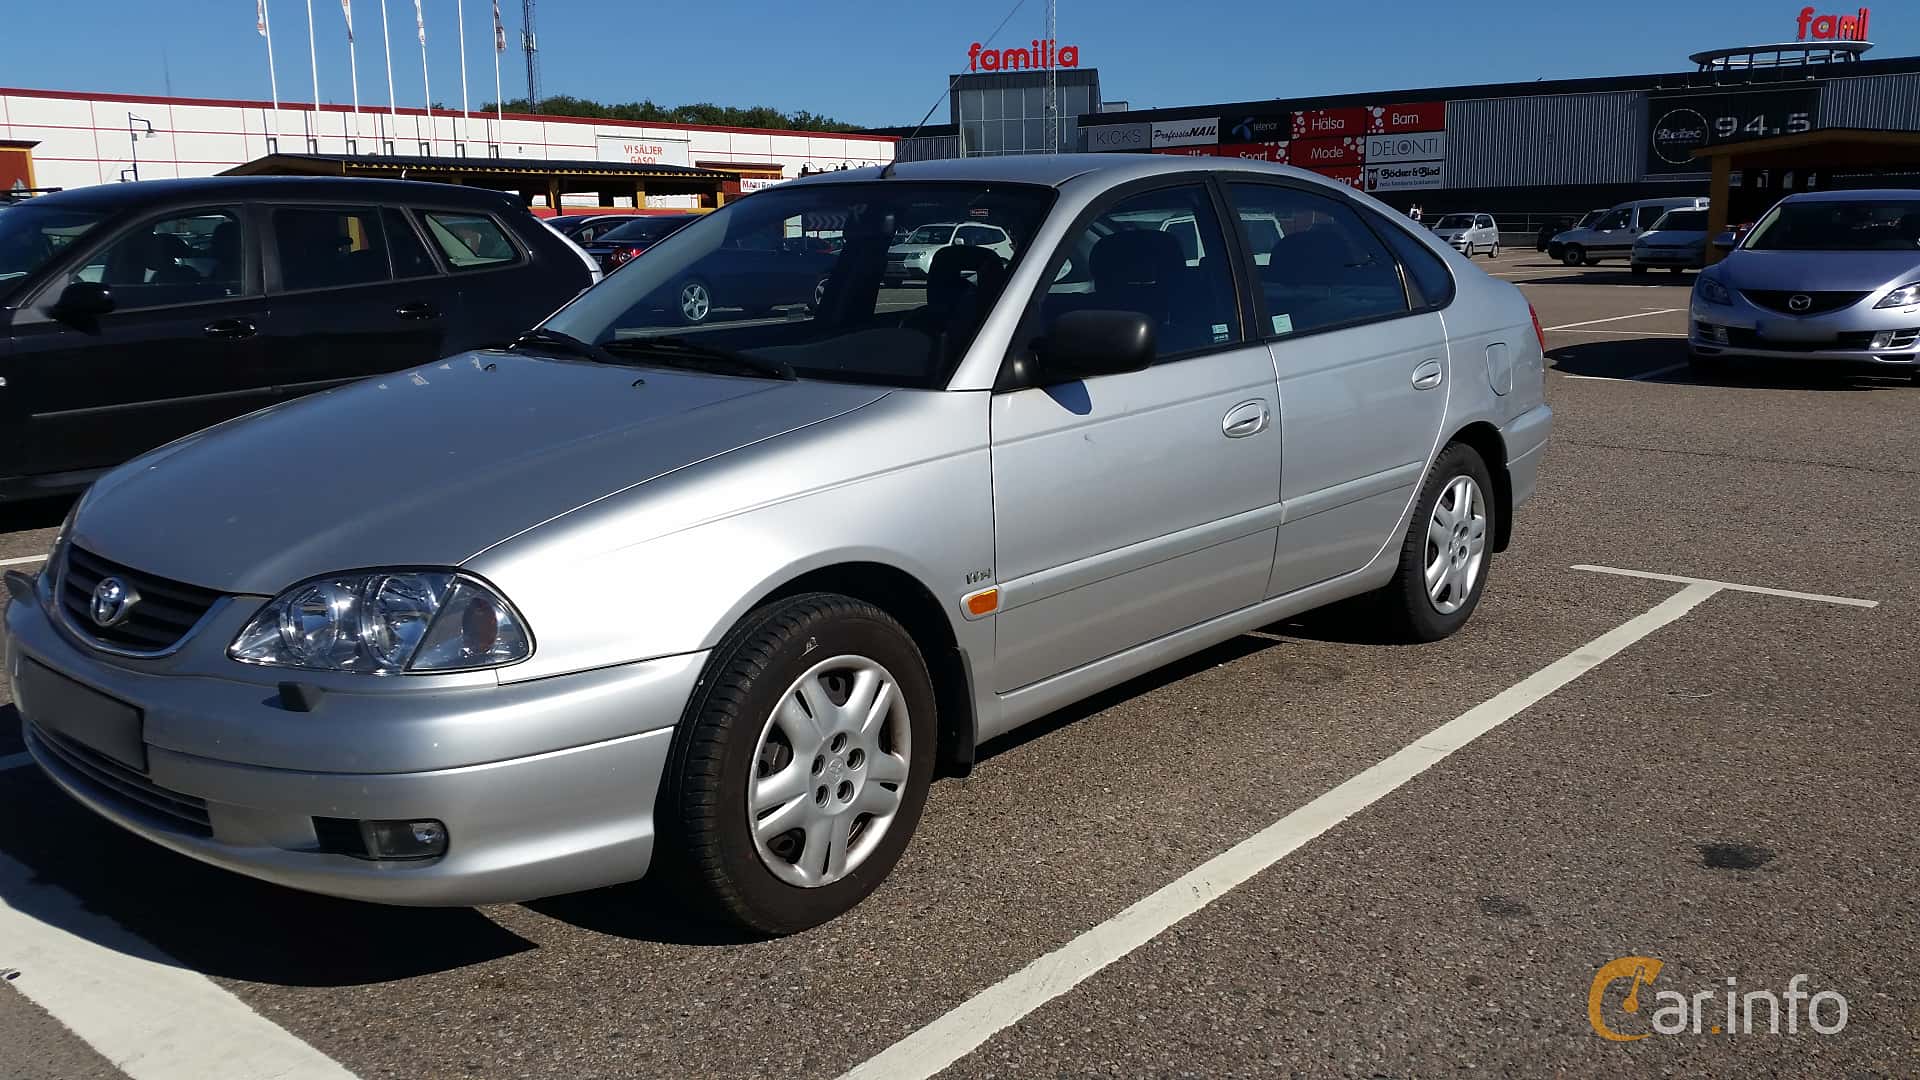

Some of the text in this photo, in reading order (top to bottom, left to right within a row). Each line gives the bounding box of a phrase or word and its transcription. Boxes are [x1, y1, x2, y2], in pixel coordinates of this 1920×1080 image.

[968, 39, 1079, 72] familia
[1311, 117, 1345, 131] Hälsa
[1392, 112, 1419, 126] Barn
[1714, 112, 1811, 137] 94.5
[1096, 128, 1142, 145] KICKS
[623, 144, 663, 156] VI SÄLJER
[1310, 146, 1344, 160] Mode
[1371, 137, 1438, 157] DELONTI
